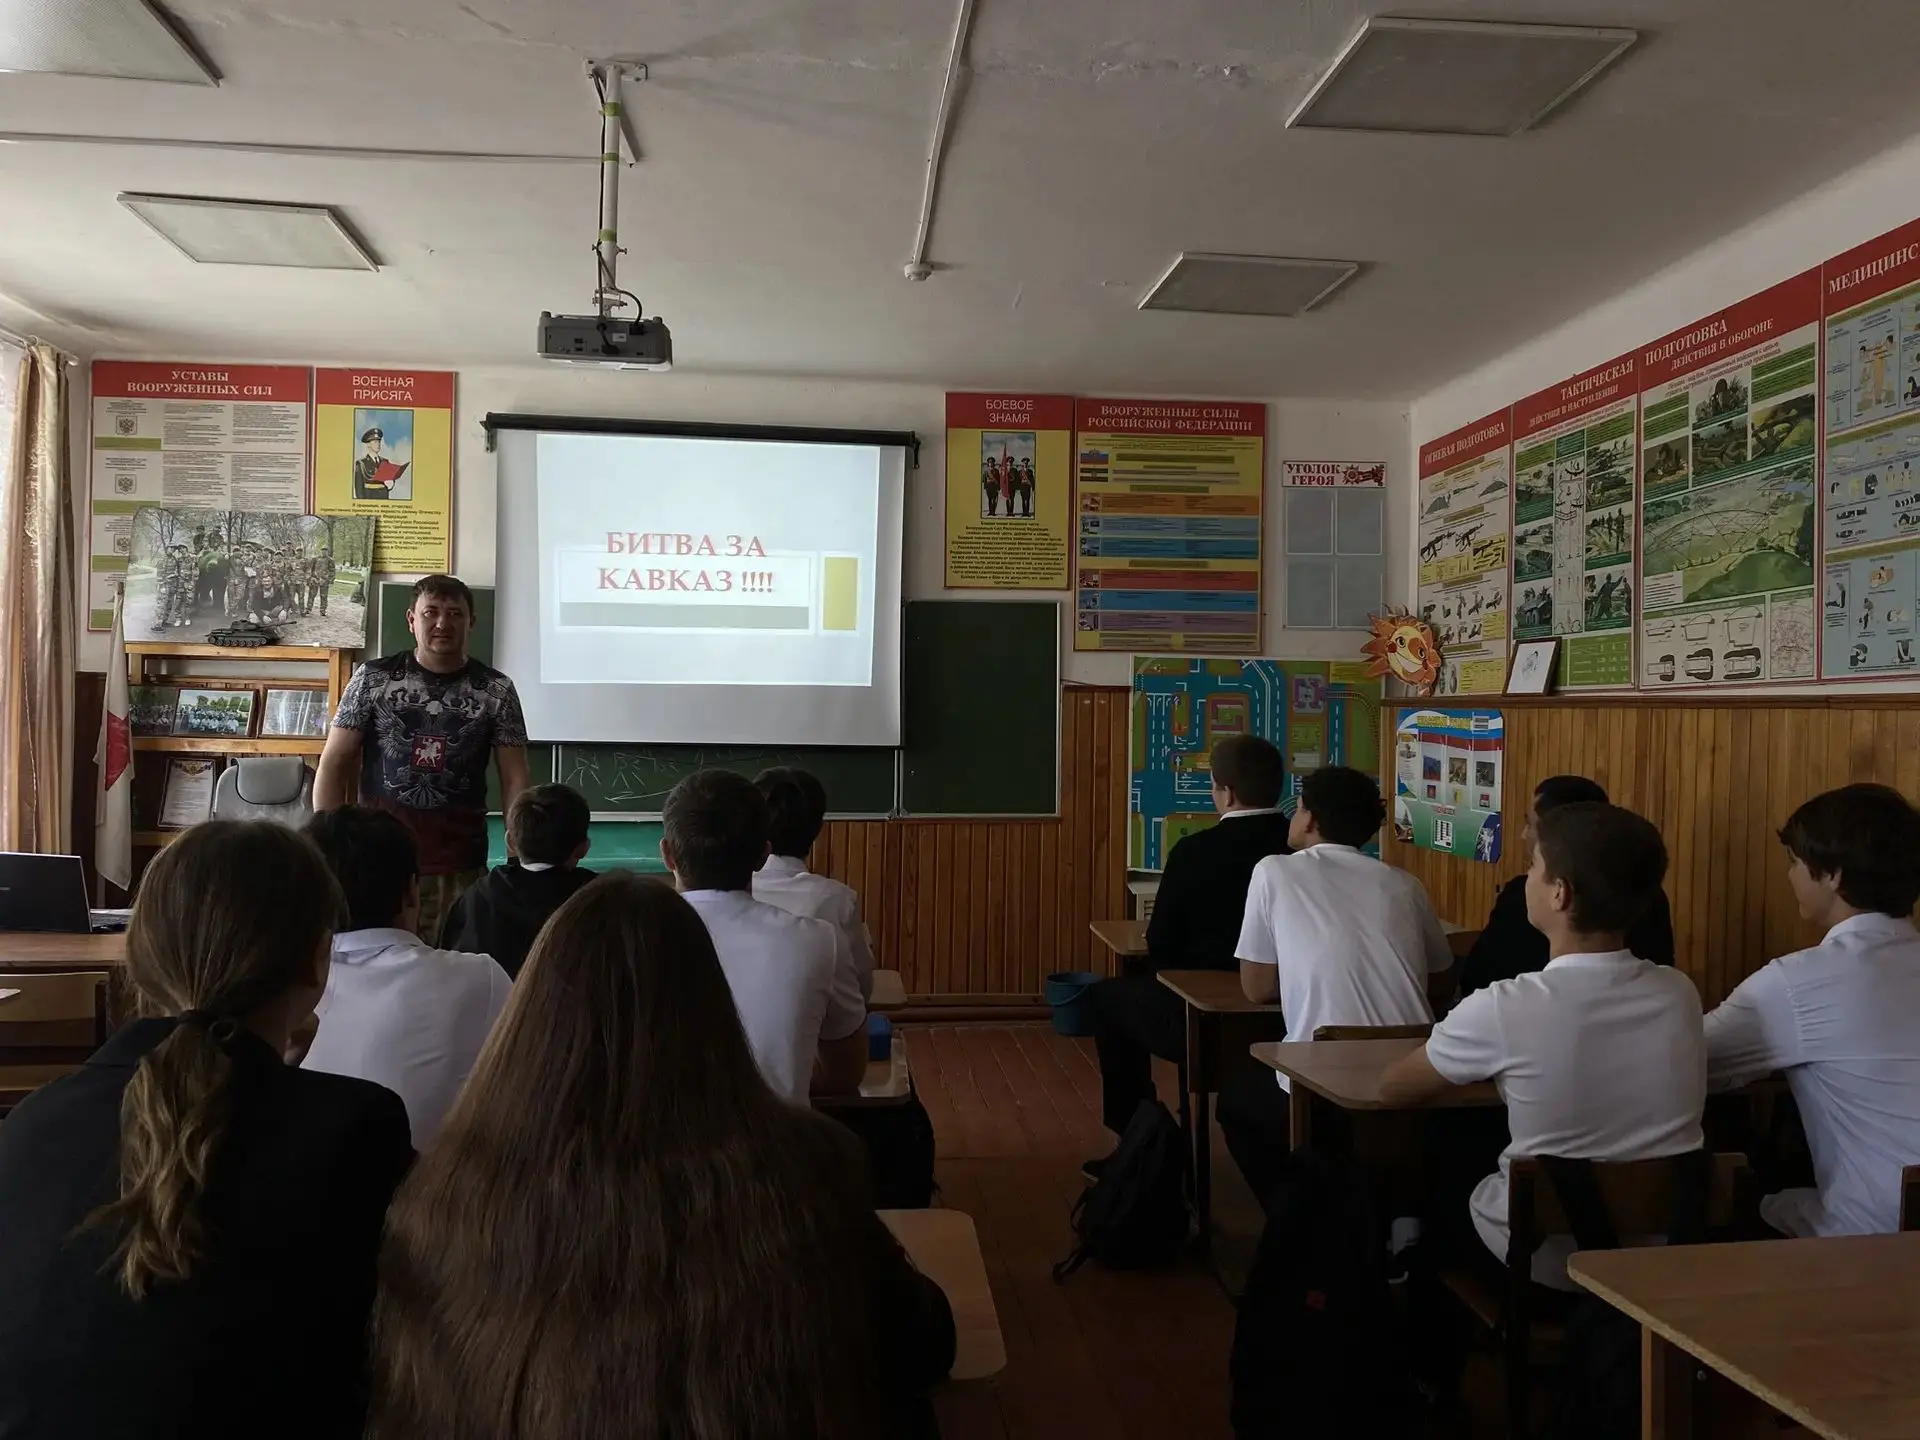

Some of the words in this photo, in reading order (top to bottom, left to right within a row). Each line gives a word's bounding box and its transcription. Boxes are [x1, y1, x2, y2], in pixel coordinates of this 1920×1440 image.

[1829, 242, 1920, 294] МЕДИЦИНС
[1645, 319, 1728, 366] ПОДГОТОВКА
[1670, 343, 1717, 371] ДЕЙСТВИЯ
[1719, 339, 1727, 350] В
[1728, 318, 1774, 345] ОБОРОНЕ
[172, 370, 229, 382] УСТАВЫ
[352, 375, 414, 388] ВОЕННАЯ
[1560, 359, 1634, 401] ТАКТИЧЕСКАЯ
[127, 382, 239, 395] ВООРУЖЕННЫХ
[243, 385, 273, 396] СИЛ
[353, 389, 413, 401] ПРИСЯГА
[985, 399, 1034, 410] БОЕВОЕ
[1101, 405, 1200, 417] ВООРУЖЕННЫЕ
[1203, 408, 1240, 418] СИЛЫ
[989, 412, 1030, 423] ЗНАМЯ
[1088, 416, 1171, 429] РОССИЙСКОЙ
[1175, 419, 1252, 431] ФЕДЕРАЦИИ
[1424, 443, 1456, 464] ОГНЕВАЯ
[1456, 422, 1505, 453] ПОДГОТОВКА
[1287, 464, 1340, 474] УГОЛОК
[1292, 475, 1335, 486] ГЕРОЯ
[605, 531, 717, 557] БИТВА
[725, 534, 767, 558] ЗА
[597, 567, 733, 592] КАВКАЗ
[741, 571, 773, 594] !!!!
